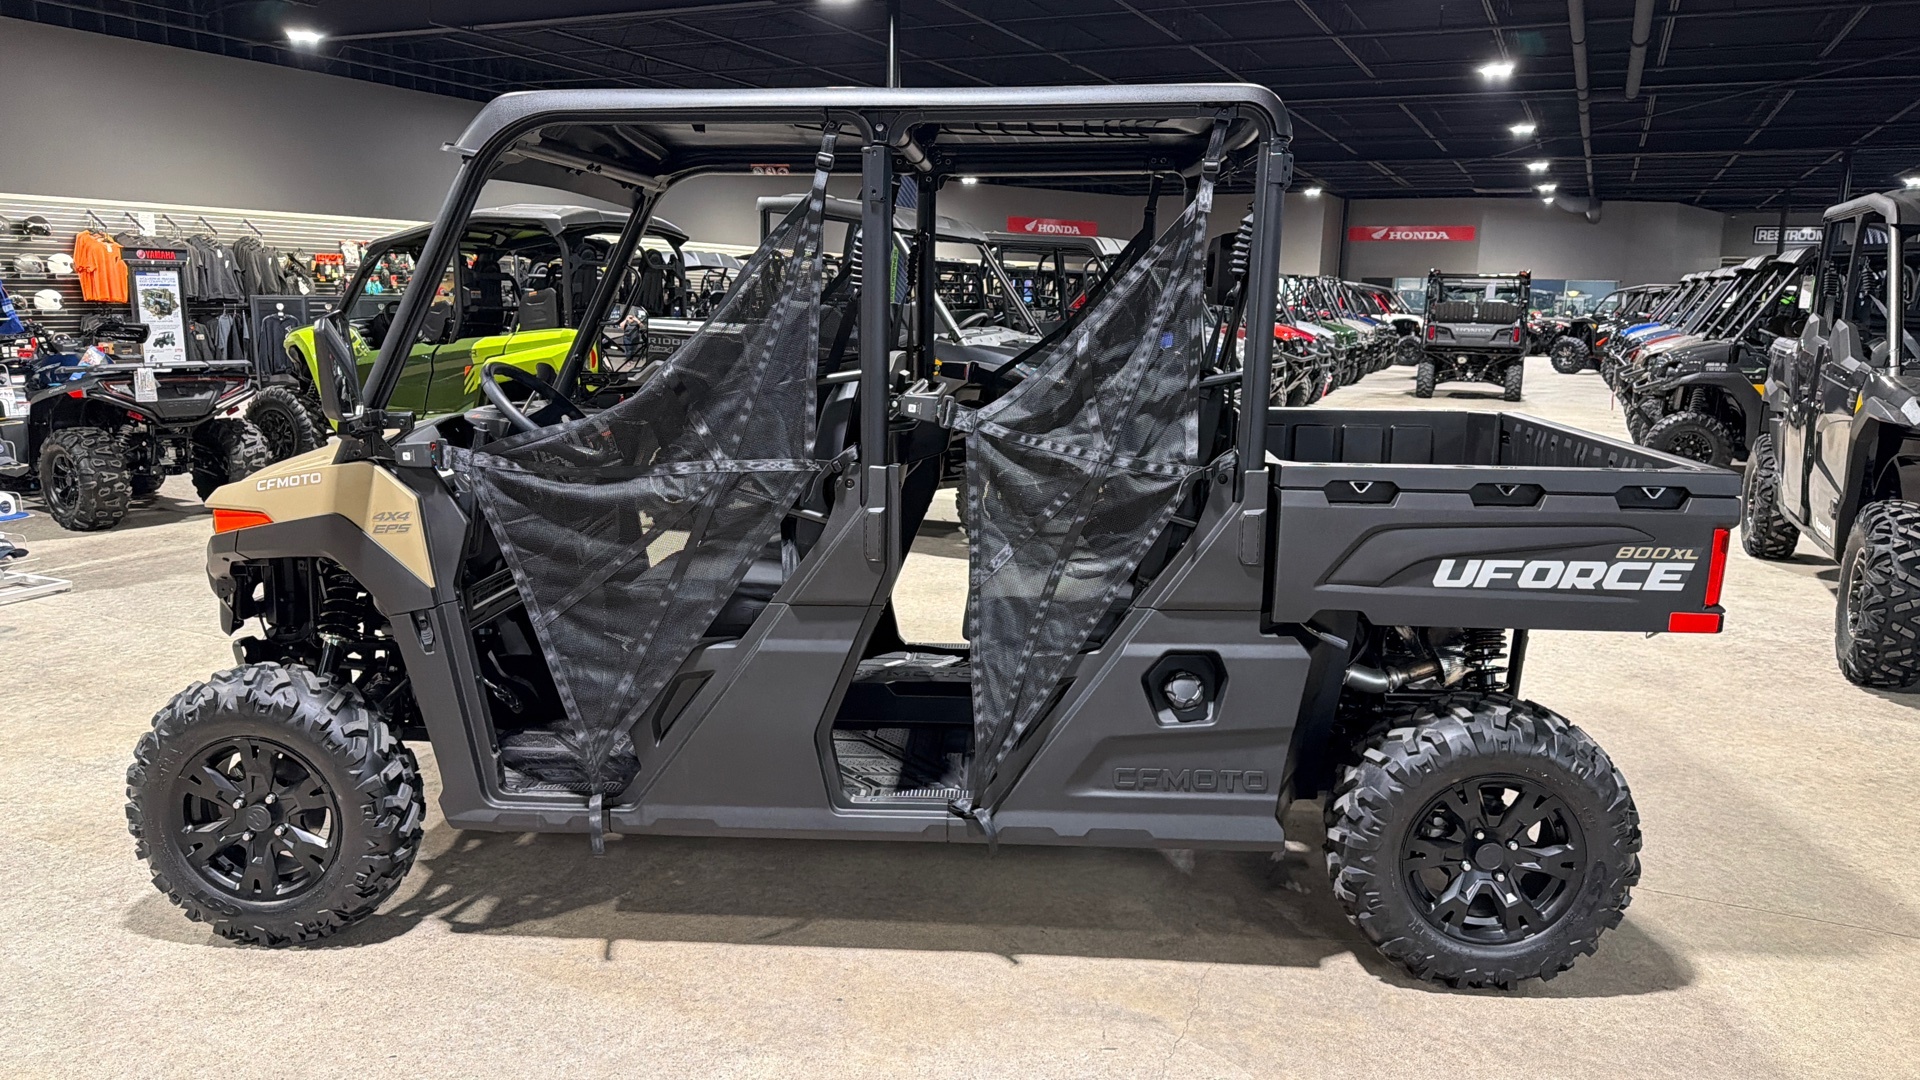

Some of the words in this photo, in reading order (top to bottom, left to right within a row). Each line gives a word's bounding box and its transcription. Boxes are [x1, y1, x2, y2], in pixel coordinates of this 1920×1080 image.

[1037, 223, 1081, 235] HONDA
[1388, 230, 1449, 240] HONDA
[145, 250, 176, 260] YAMAHA
[256, 472, 321, 492] CFMOTO
[373, 511, 411, 521] 4X4
[373, 523, 412, 534] EPS
[1432, 559, 1696, 592] UFORCE
[1112, 767, 1269, 793] CFMOTO
